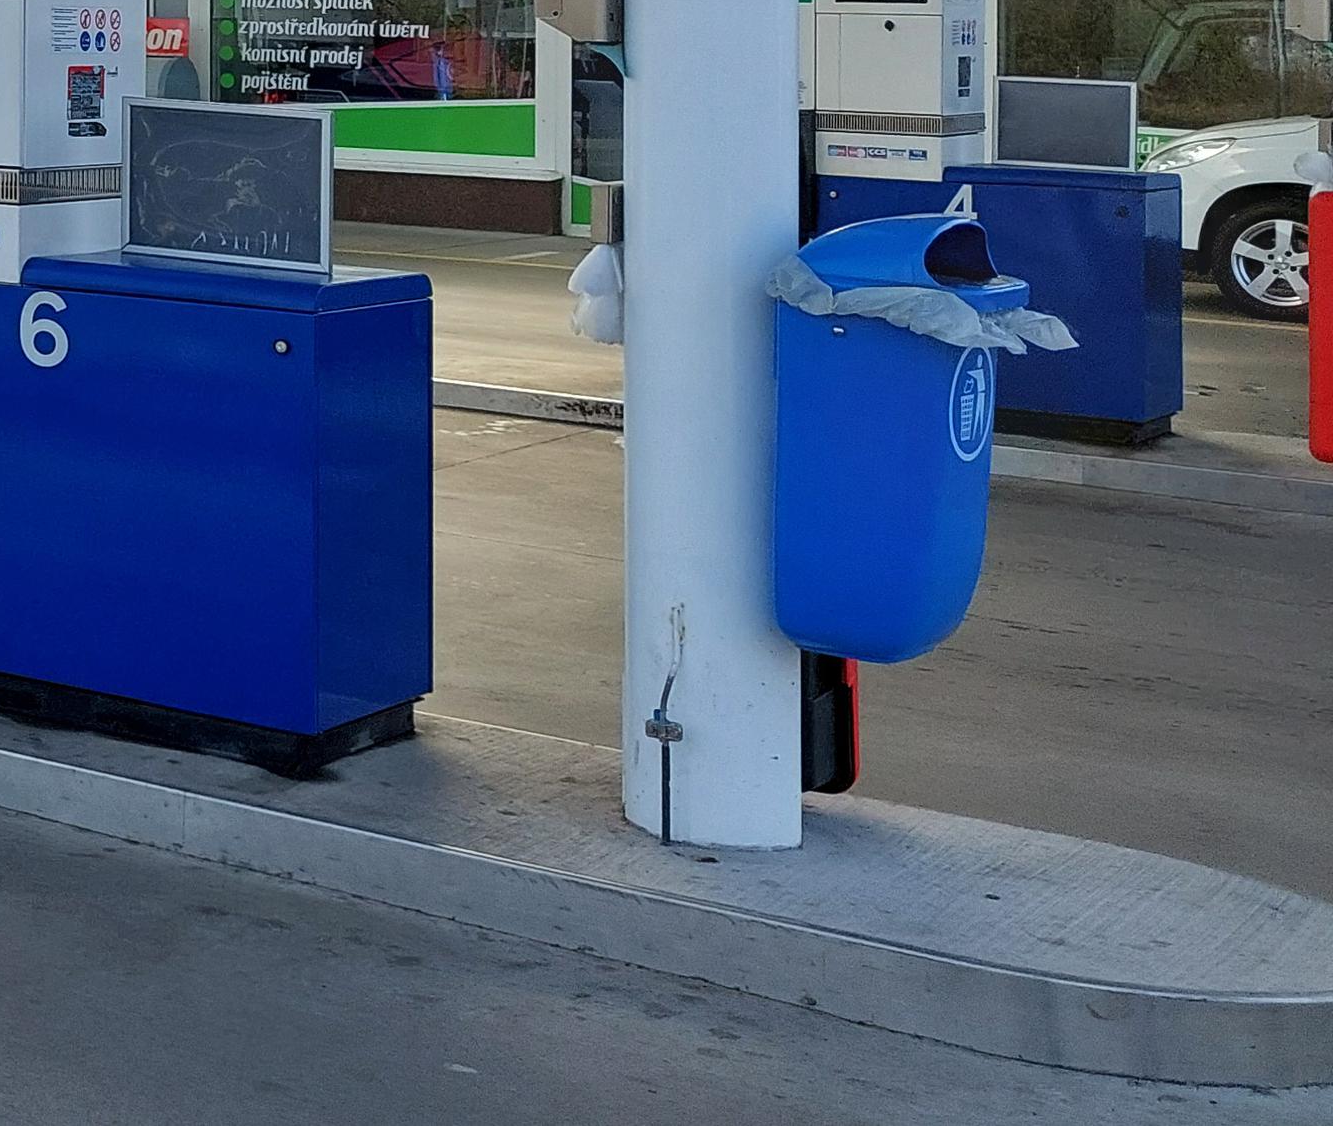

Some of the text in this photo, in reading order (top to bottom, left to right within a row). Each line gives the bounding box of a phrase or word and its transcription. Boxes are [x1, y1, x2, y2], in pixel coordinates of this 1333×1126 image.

[237, 17, 430, 39] zprostředkování úvěru
[241, 43, 364, 69] komisní prodej
[241, 71, 310, 93] pojištění
[943, 184, 978, 220] 4
[19, 291, 69, 367] 6
